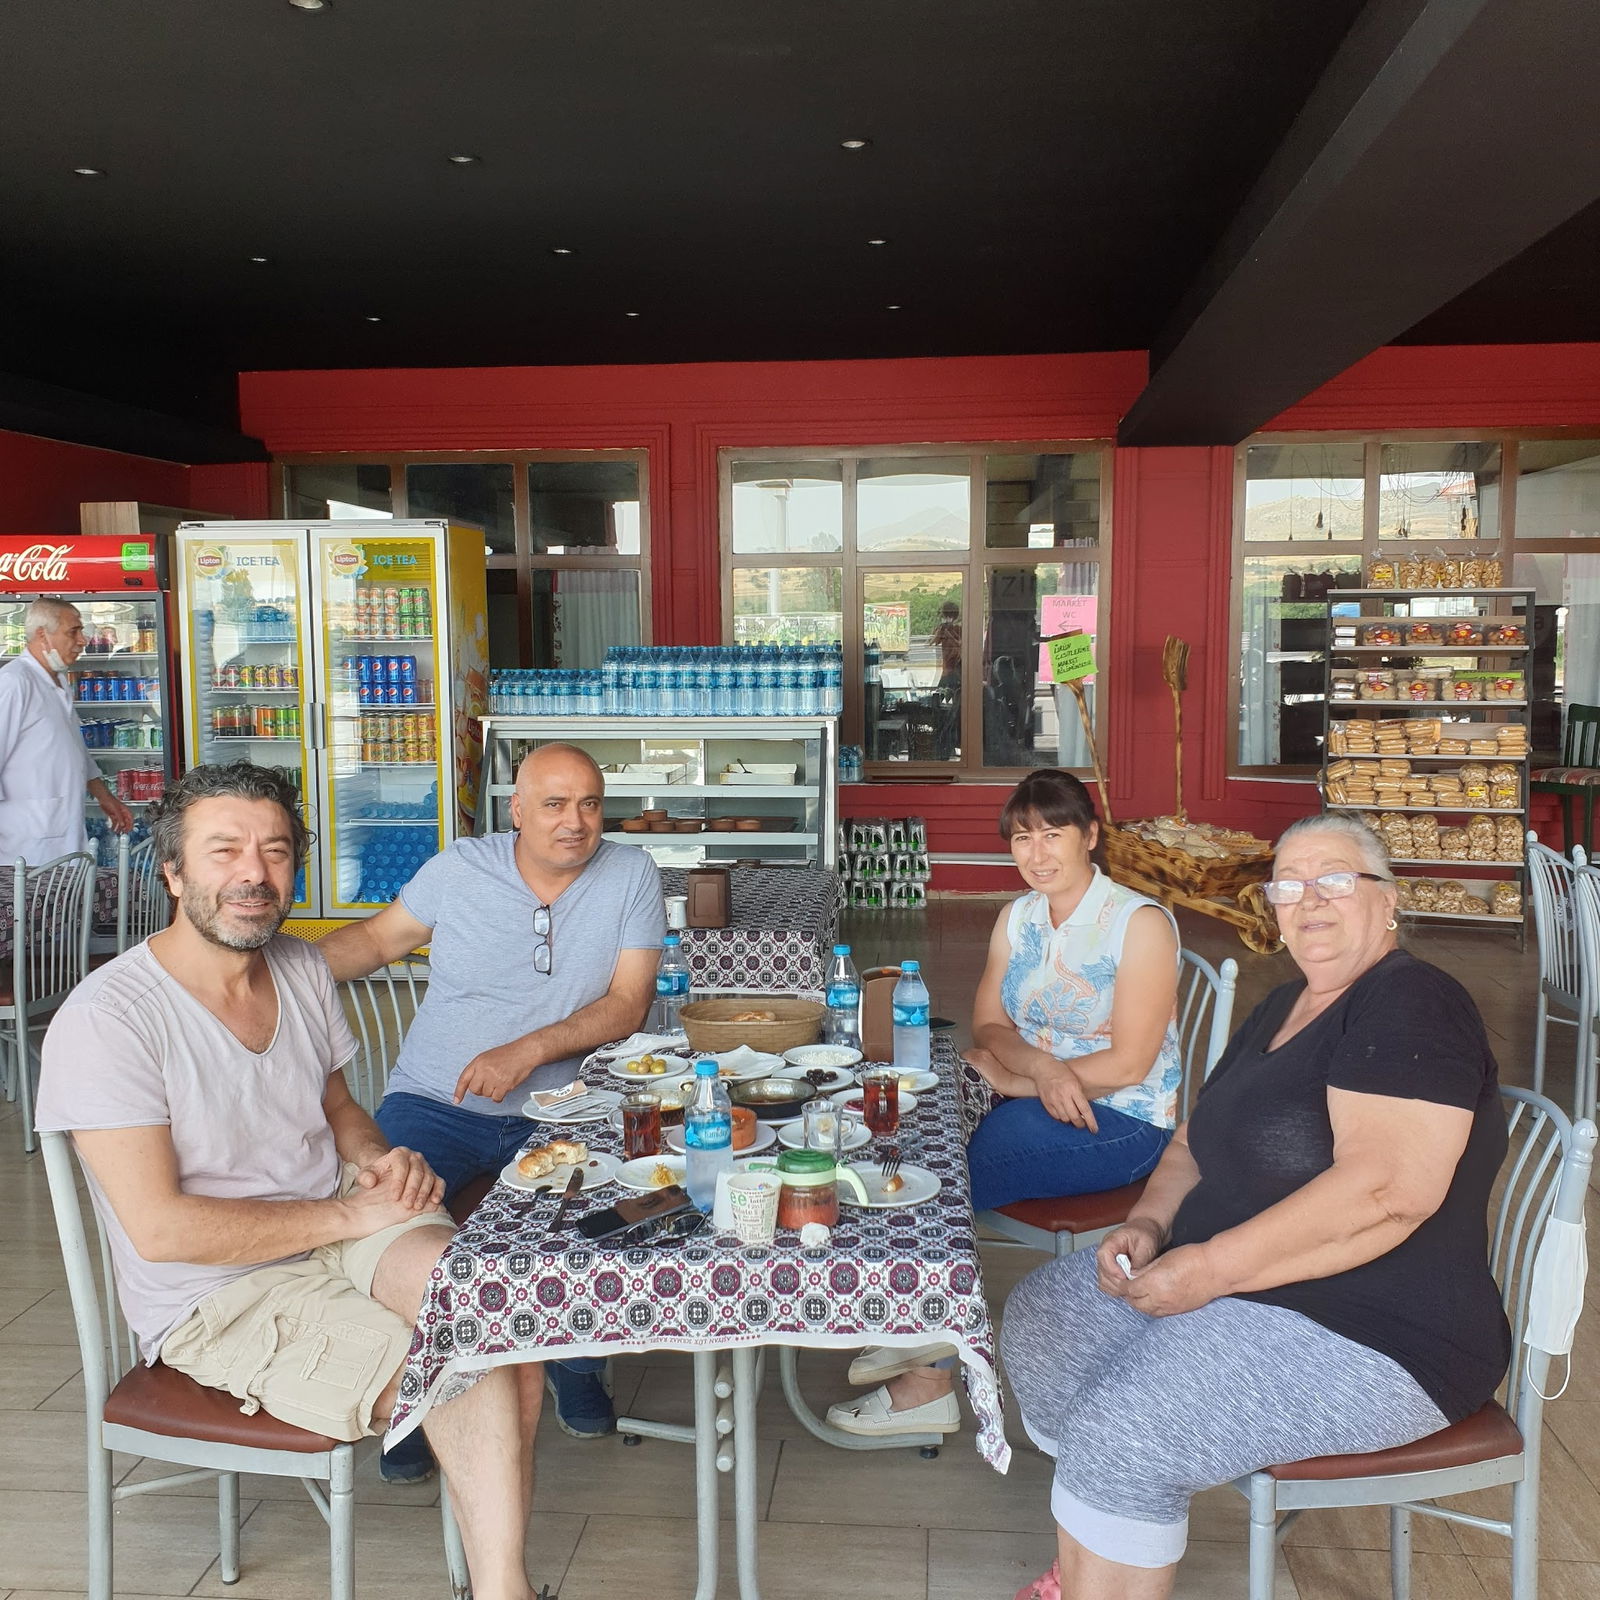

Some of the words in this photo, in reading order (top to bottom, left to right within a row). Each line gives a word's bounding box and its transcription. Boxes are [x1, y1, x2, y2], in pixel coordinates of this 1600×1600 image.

[200, 557, 221, 566] Lipton
[236, 556, 258, 567] ICE
[259, 556, 280, 567] TEA
[335, 555, 357, 565] Lipton
[373, 555, 393, 565] ICE
[395, 555, 418, 565] TEA
[1052, 599, 1087, 607] MARKET
[1062, 611, 1076, 619] WC
